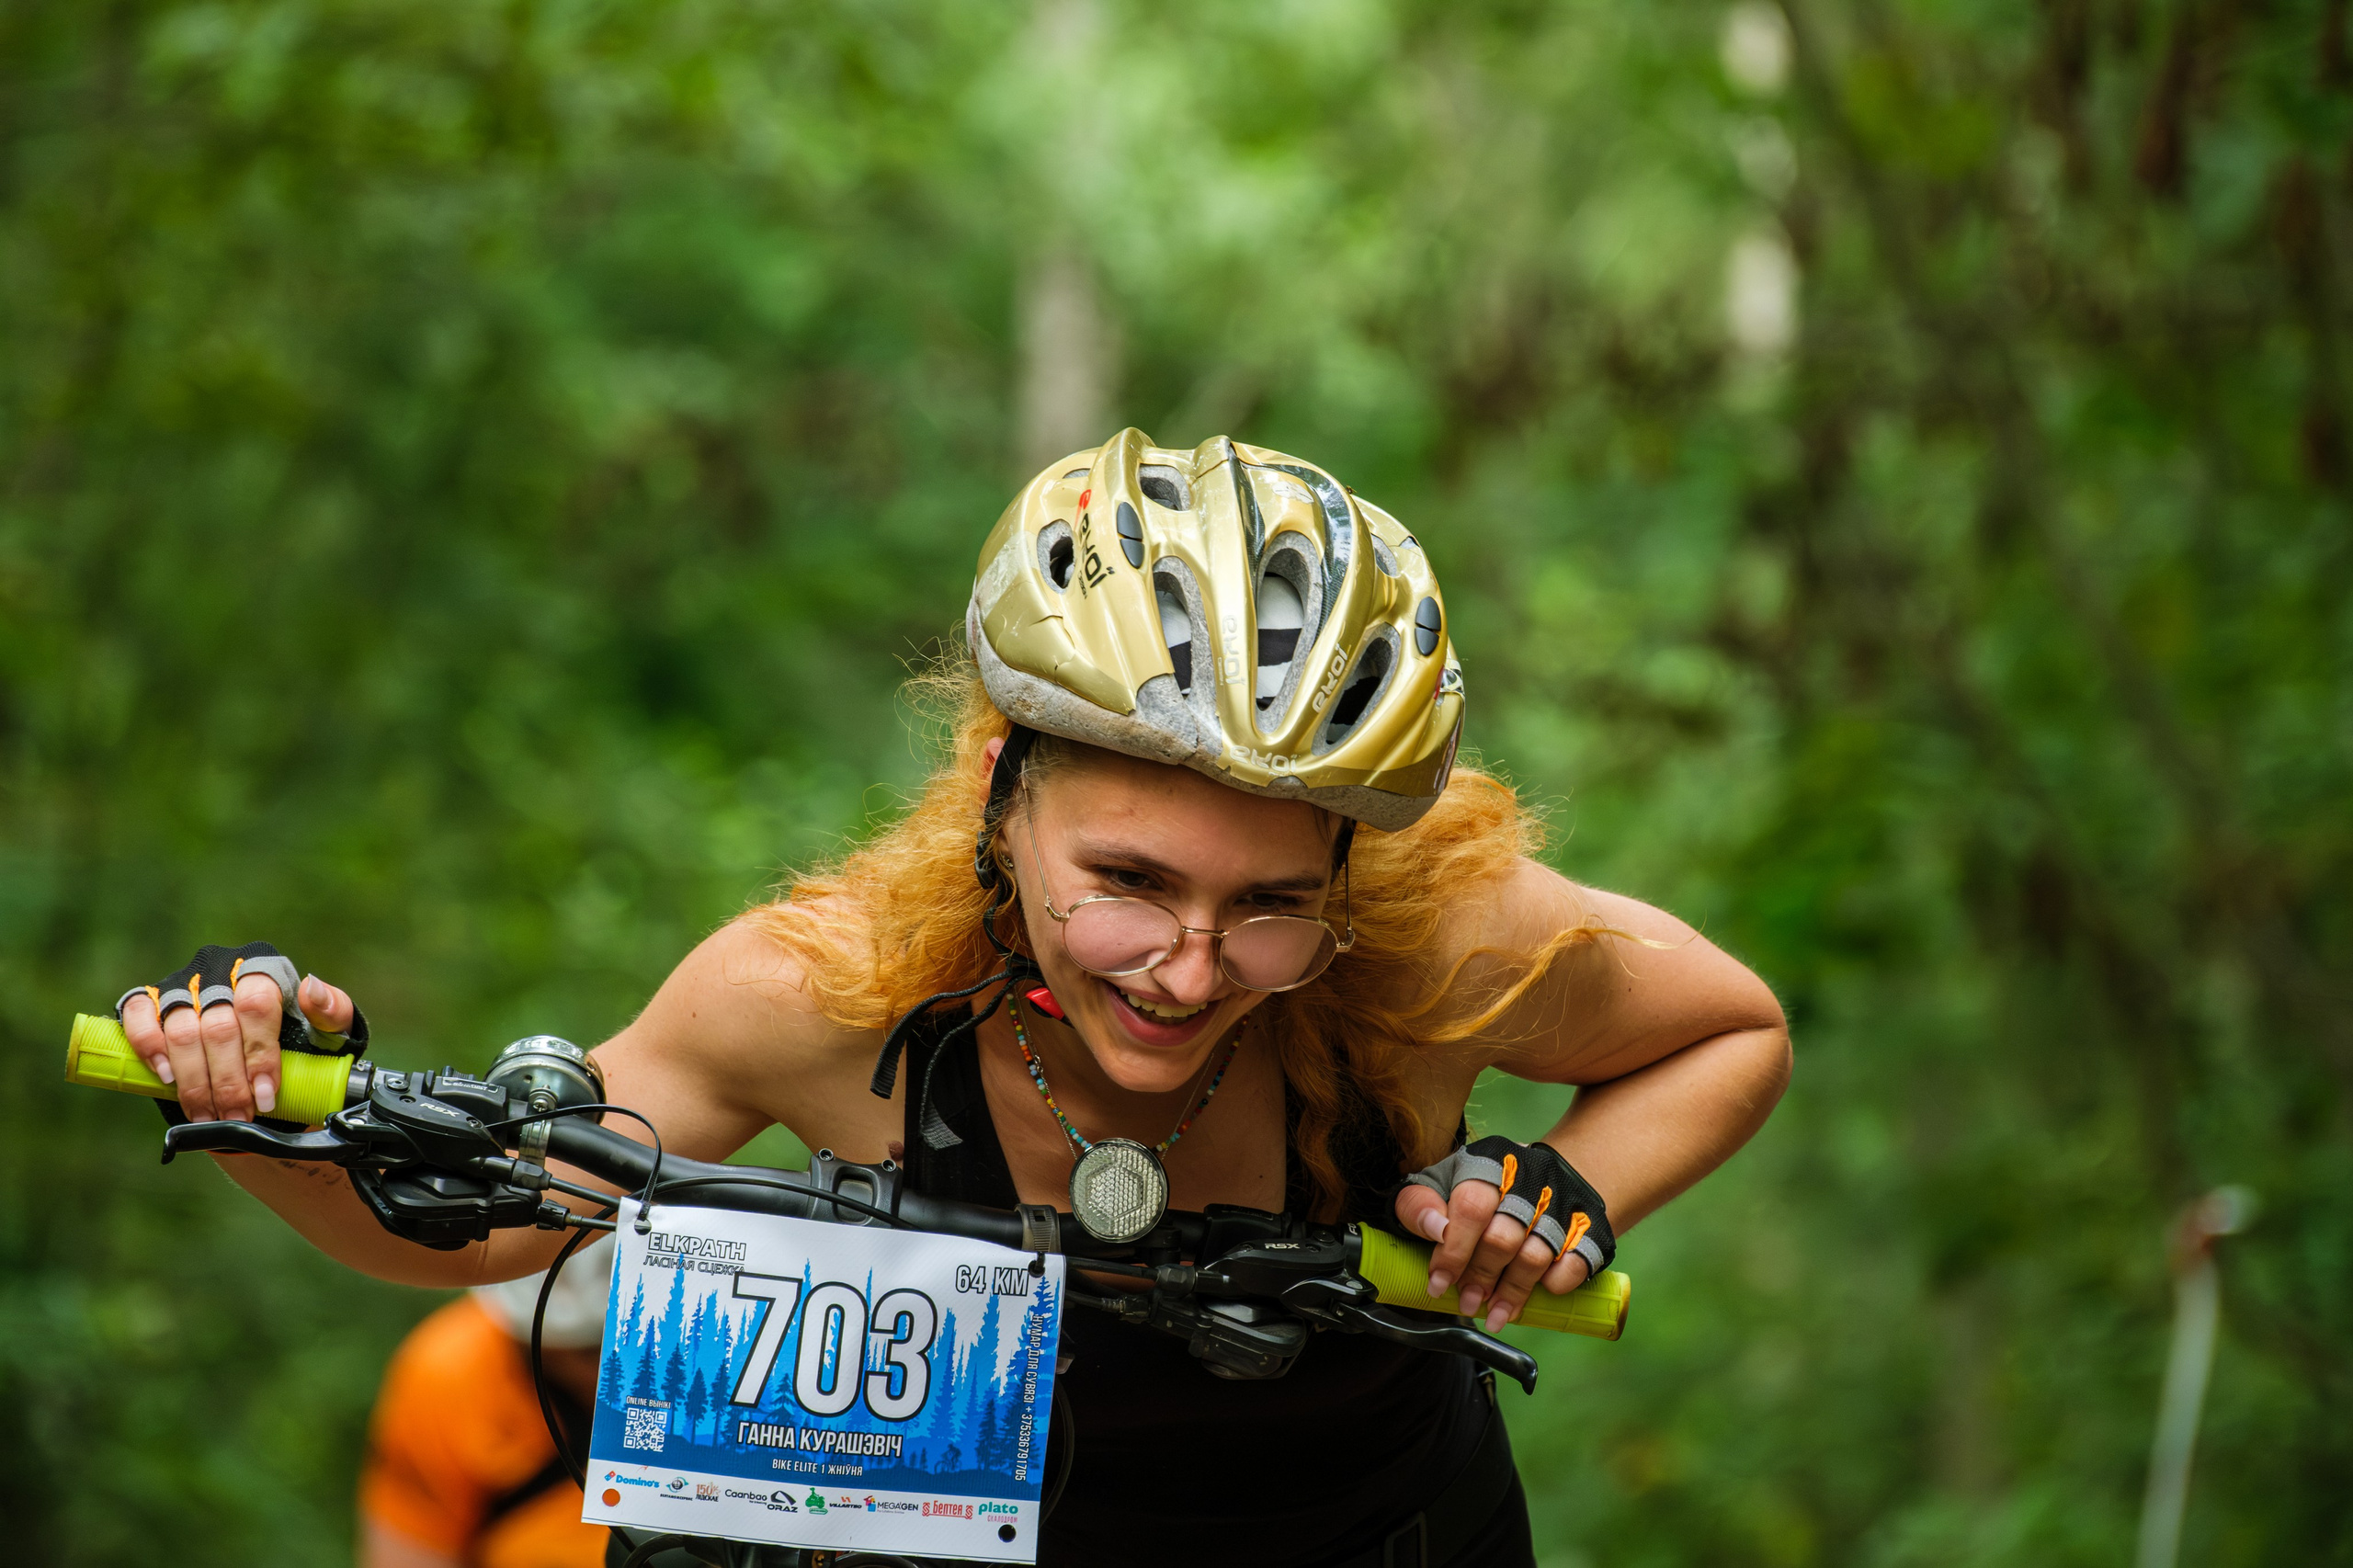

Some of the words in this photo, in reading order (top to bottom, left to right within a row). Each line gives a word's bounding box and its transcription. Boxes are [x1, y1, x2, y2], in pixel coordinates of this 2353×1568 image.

[420, 1103, 460, 1118] RSX
[648, 1232, 746, 1261] ELKPATH
[643, 1255, 695, 1271] ЛАСІНАЯ
[956, 1265, 986, 1294] 64
[1029, 1314, 1044, 1348] НУМАР
[730, 1270, 938, 1422] 703
[1027, 1348, 1040, 1369] ДЛЯ
[626, 1395, 647, 1406] ONLINE
[737, 1421, 796, 1449] ГАННА
[799, 1428, 904, 1458] КУРАШЭВІЧ
[1015, 1414, 1033, 1481] 375336791705
[772, 1459, 792, 1471] BIKE
[793, 1460, 818, 1473] ELITE
[615, 1474, 660, 1488] Domino's
[724, 1489, 767, 1501] Caanbao
[767, 1504, 798, 1513] ORAZ
[978, 1501, 1018, 1515] plato
